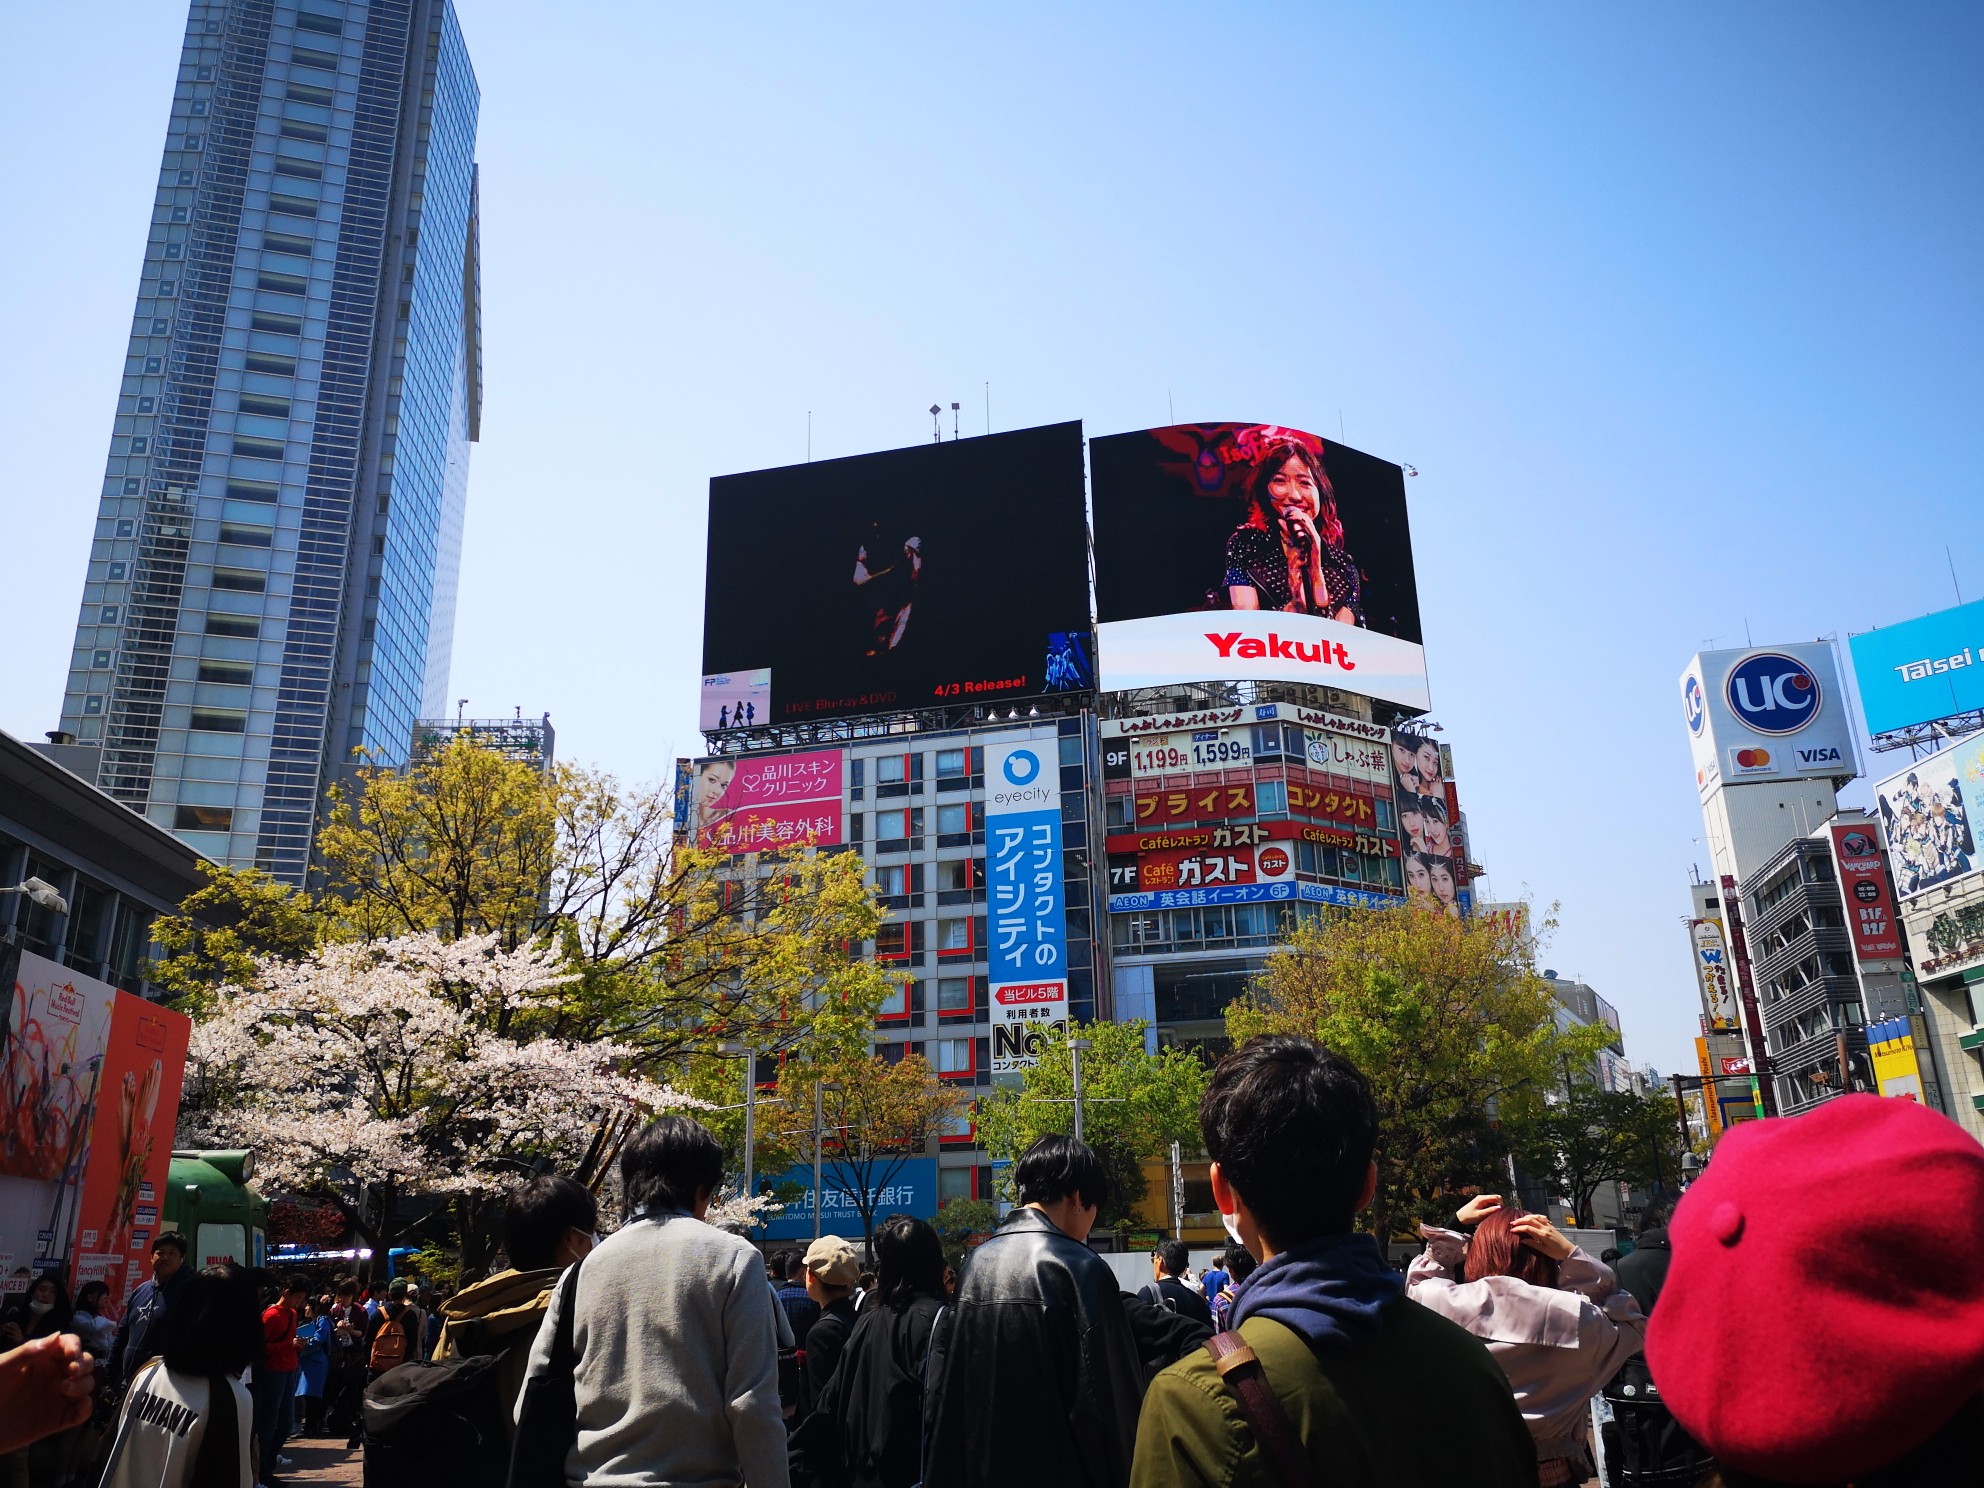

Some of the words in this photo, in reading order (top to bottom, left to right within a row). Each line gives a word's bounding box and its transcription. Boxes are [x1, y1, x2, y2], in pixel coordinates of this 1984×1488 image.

[1204, 632, 1356, 671] Yakult
[1894, 647, 1973, 683] Taisei
[934, 683, 960, 697] 4/3
[964, 676, 1027, 692] Release!
[785, 702, 812, 714] LIVE
[1119, 708, 1244, 734] しゃぶしゃぶバイキング
[1106, 751, 1128, 767] 9F
[1134, 747, 1188, 774] 1,199円
[1193, 741, 1250, 768] 1,599円
[1333, 741, 1386, 773] しゃぶ葉
[1796, 748, 1841, 763] VISA
[762, 759, 836, 781] 品川スキン
[762, 776, 828, 797] クリニック
[994, 788, 1051, 807] eyecity
[1137, 787, 1251, 819] プライス
[1287, 785, 1373, 820] コンタクト
[717, 815, 835, 846] 品川美容外科
[1213, 825, 1270, 848] ガスト
[1355, 834, 1394, 858] ガスト
[1143, 863, 1174, 878] Café
[1178, 856, 1249, 887] ガスト
[1262, 860, 1287, 869] ガスト
[1455, 856, 1464, 881] ガスト
[1841, 860, 1881, 872] VANGUARD
[1110, 866, 1137, 885] 7F
[1144, 877, 1174, 886] レストラン
[995, 827, 1029, 968] アイシティ
[1032, 824, 1058, 966] コンタクトの
[1115, 896, 1149, 908] AEON
[1159, 886, 1265, 908] 英会話イーオン
[1271, 884, 1289, 897] 6F
[1304, 885, 1330, 899] AEON
[1858, 907, 1883, 921] B1F
[1861, 922, 1887, 936] B2F
[1004, 986, 1059, 1002] 当ビル5階
[1006, 1007, 1051, 1020] 利用者数
[993, 1060, 1041, 1071] コンタクト
[833, 1210, 856, 1219] TRUST
